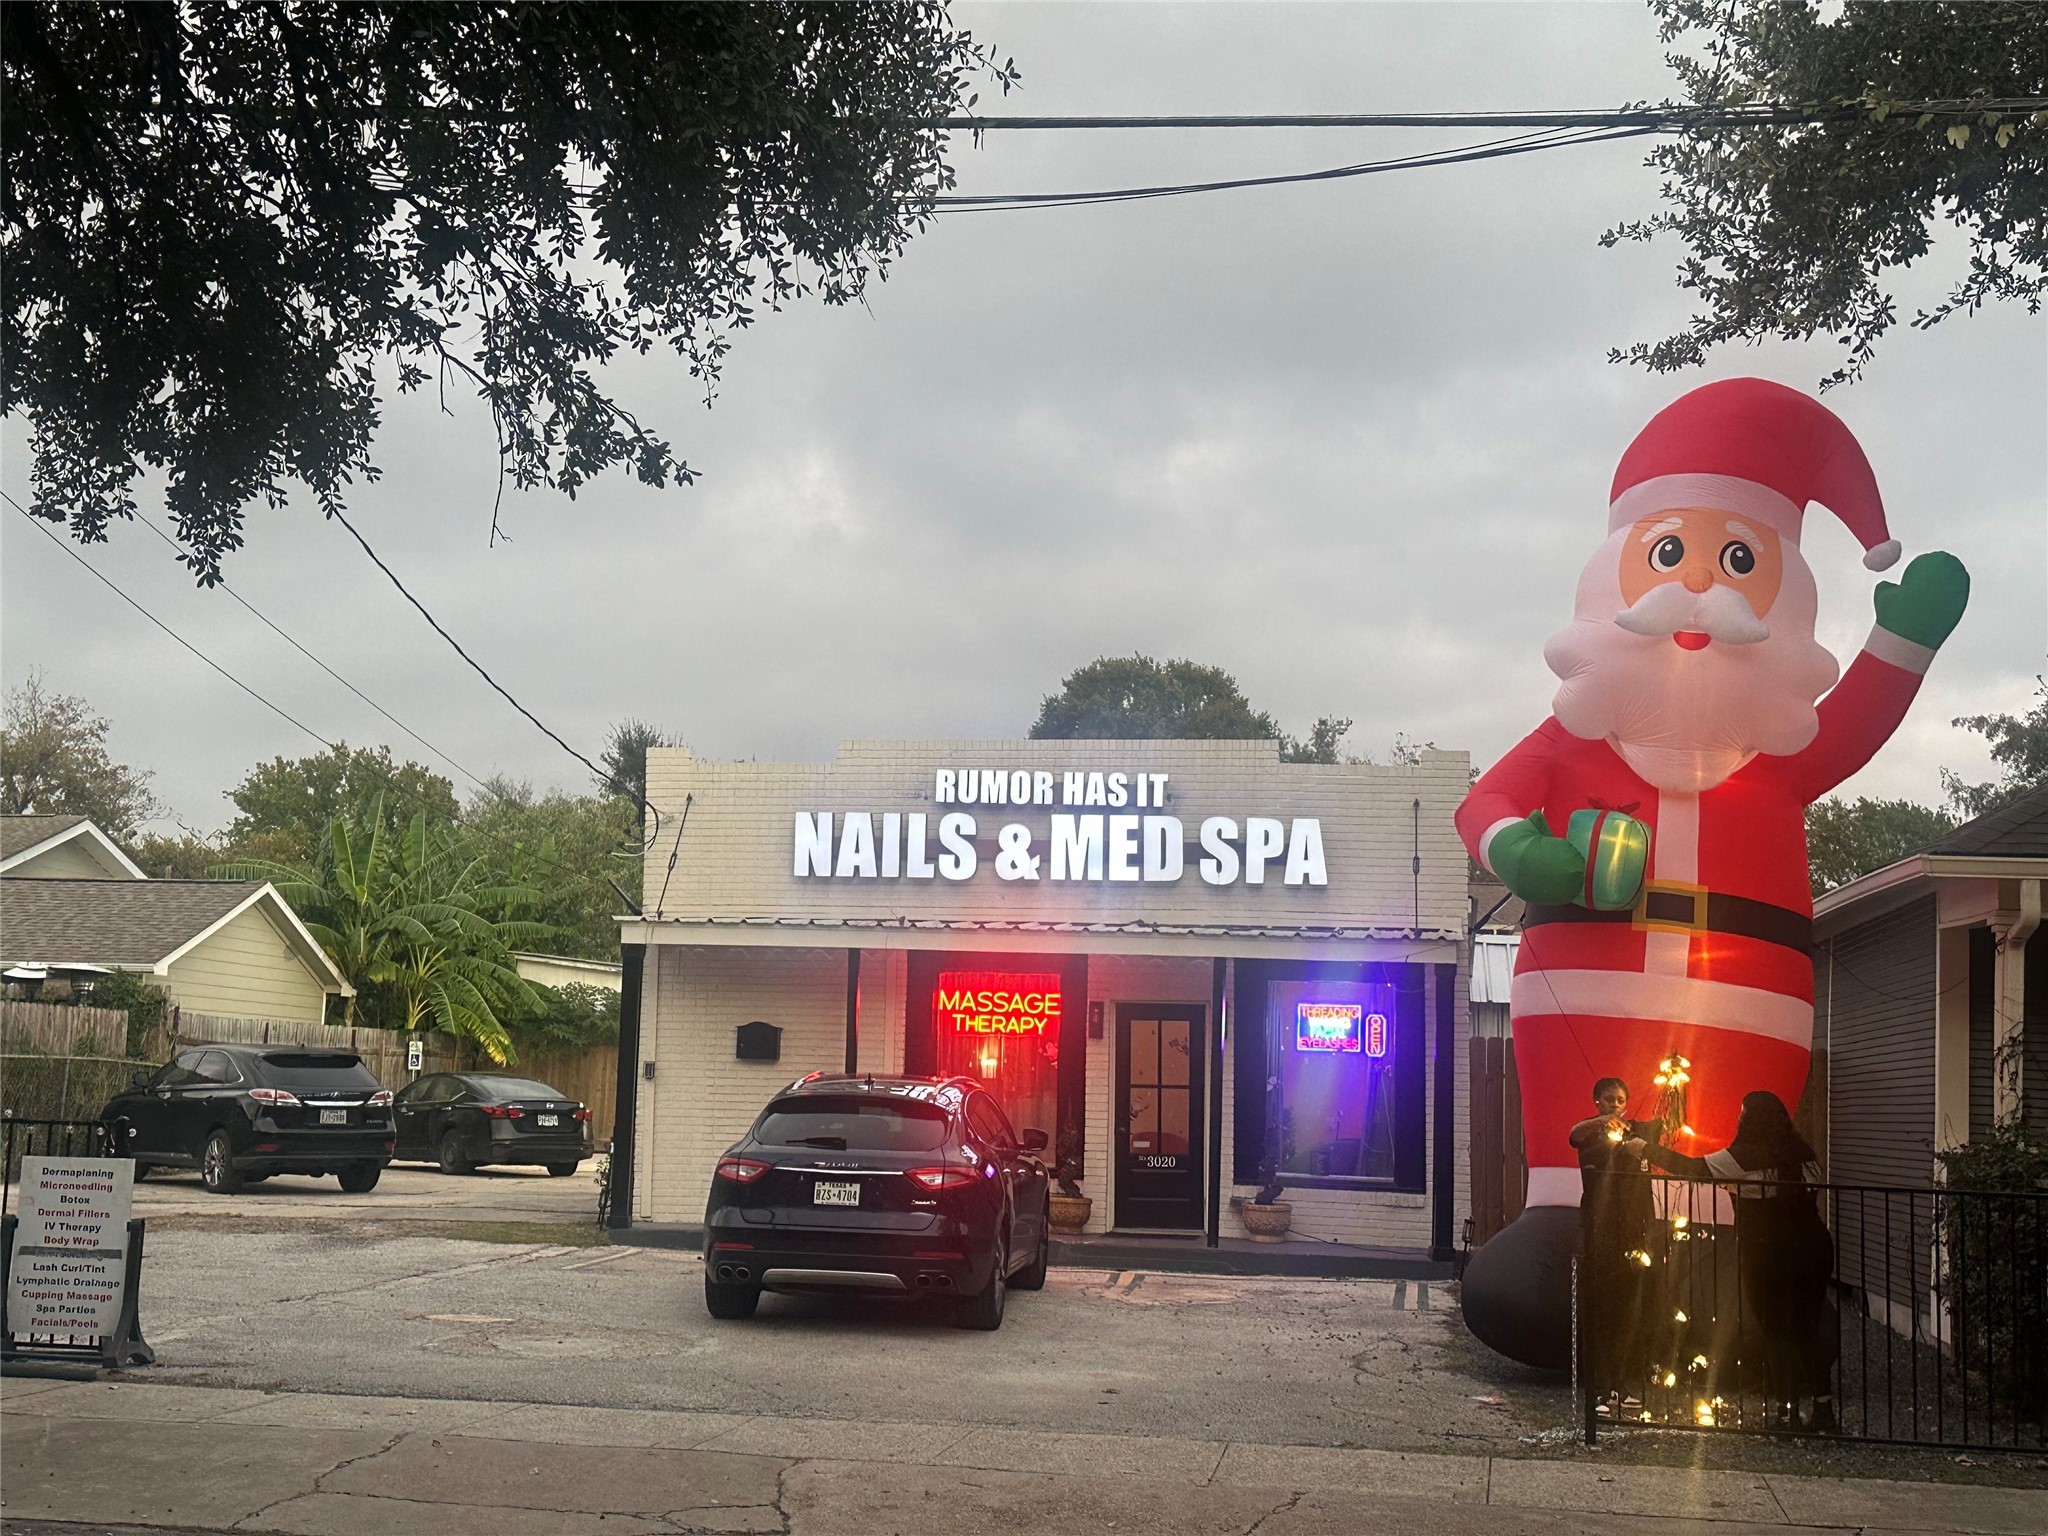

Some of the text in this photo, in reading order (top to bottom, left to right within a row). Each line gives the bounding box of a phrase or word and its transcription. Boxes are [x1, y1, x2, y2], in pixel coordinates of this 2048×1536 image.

[935, 768, 1169, 807] RUMOR HAS IT
[794, 811, 1328, 886] NAILS & MED SPA
[939, 990, 1061, 1015] MASSAGE
[952, 1014, 1048, 1035] THERAPY
[1147, 1155, 1176, 1168] 3020
[42, 1167, 114, 1179] Dermaplaning
[40, 1180, 113, 1193] Microneedling
[60, 1195, 90, 1204] Botox
[38, 1208, 111, 1219] Dermal Fillers
[44, 1221, 102, 1233] IV Therapy
[44, 1235, 100, 1247] Body Wrap
[33, 1263, 105, 1273] Lash Curl/Tint
[16, 1276, 120, 1289] Lymphatic Drainage
[21, 1290, 113, 1303] Cupping Massage
[36, 1304, 96, 1314] Spa Parties
[31, 1317, 99, 1328] Facials/Peels
